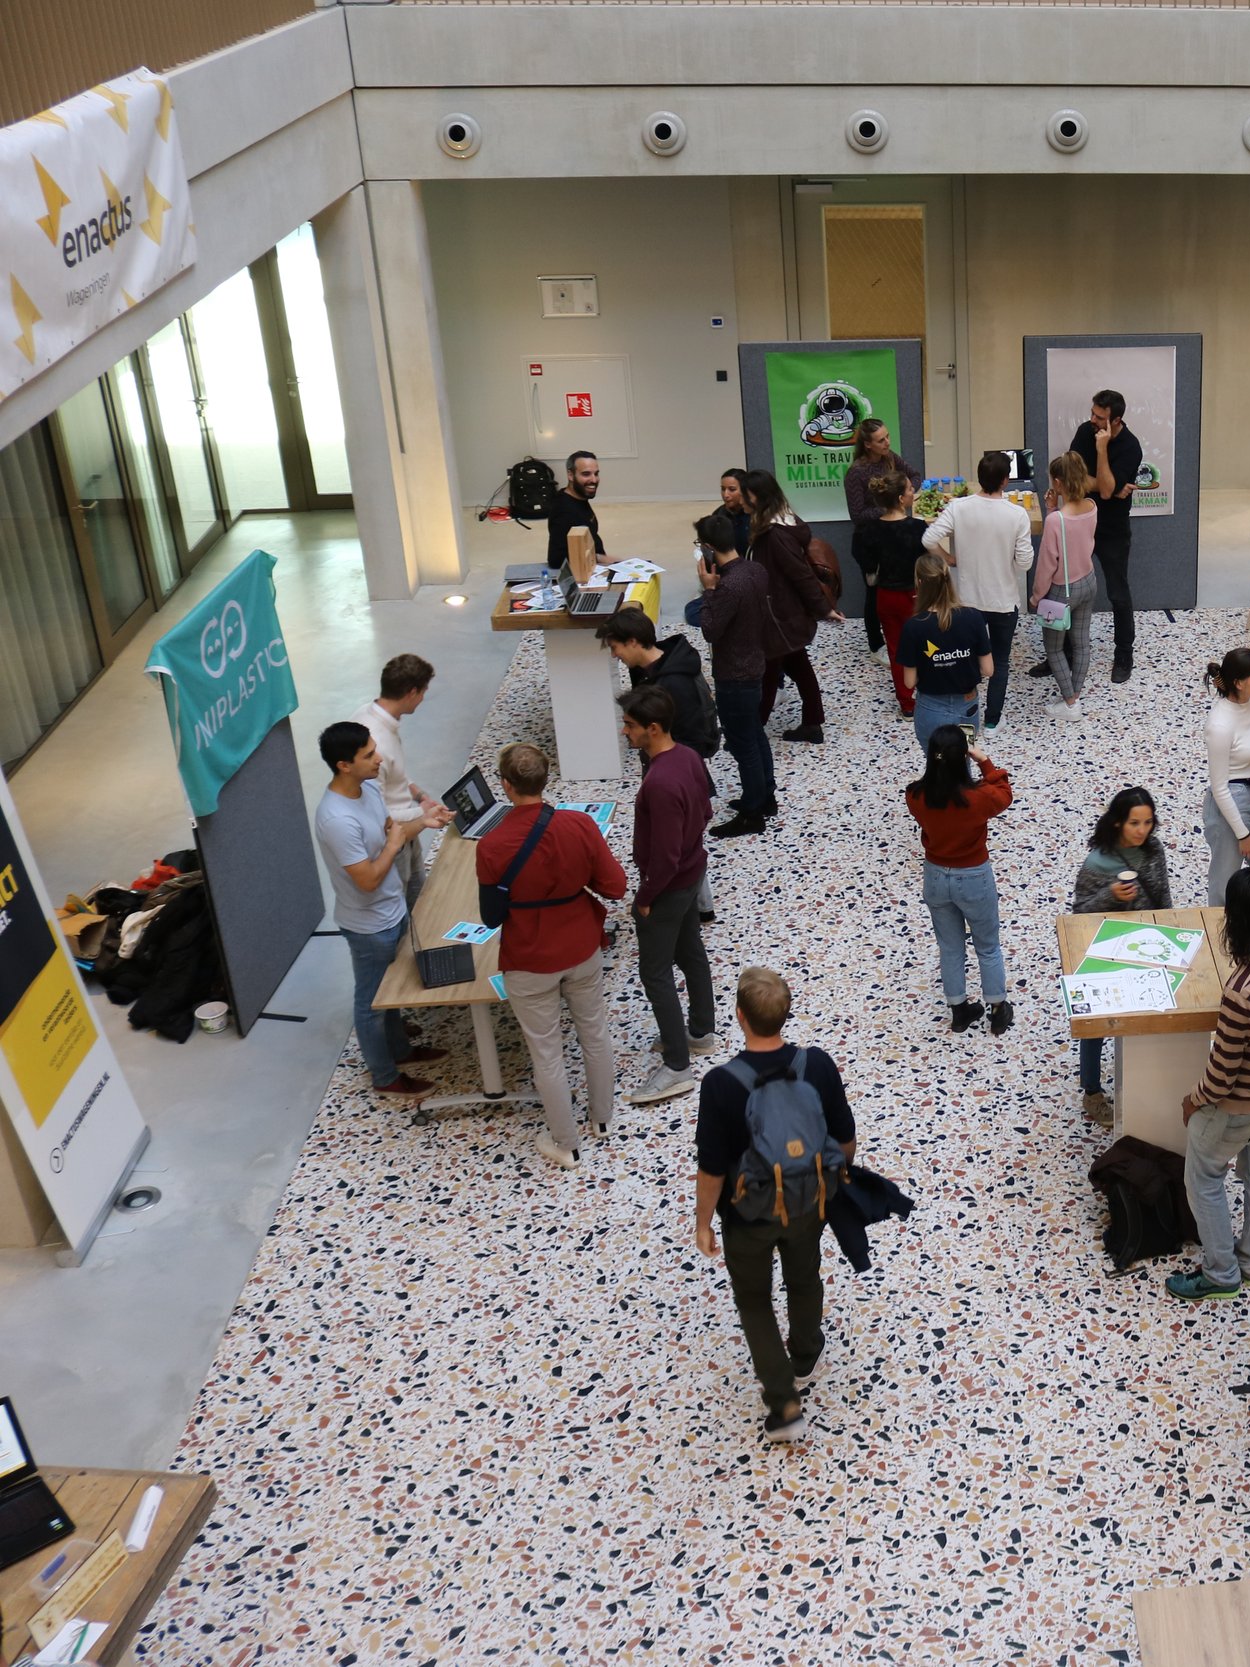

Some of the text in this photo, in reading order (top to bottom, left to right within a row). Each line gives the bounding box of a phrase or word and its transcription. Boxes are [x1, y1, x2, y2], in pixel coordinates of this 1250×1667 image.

[62, 195, 132, 269] enactus
[66, 271, 110, 308] Wageningen
[823, 452, 851, 464] TRAV
[795, 481, 841, 489] SUSTAINABLE
[932, 648, 971, 662] enactus
